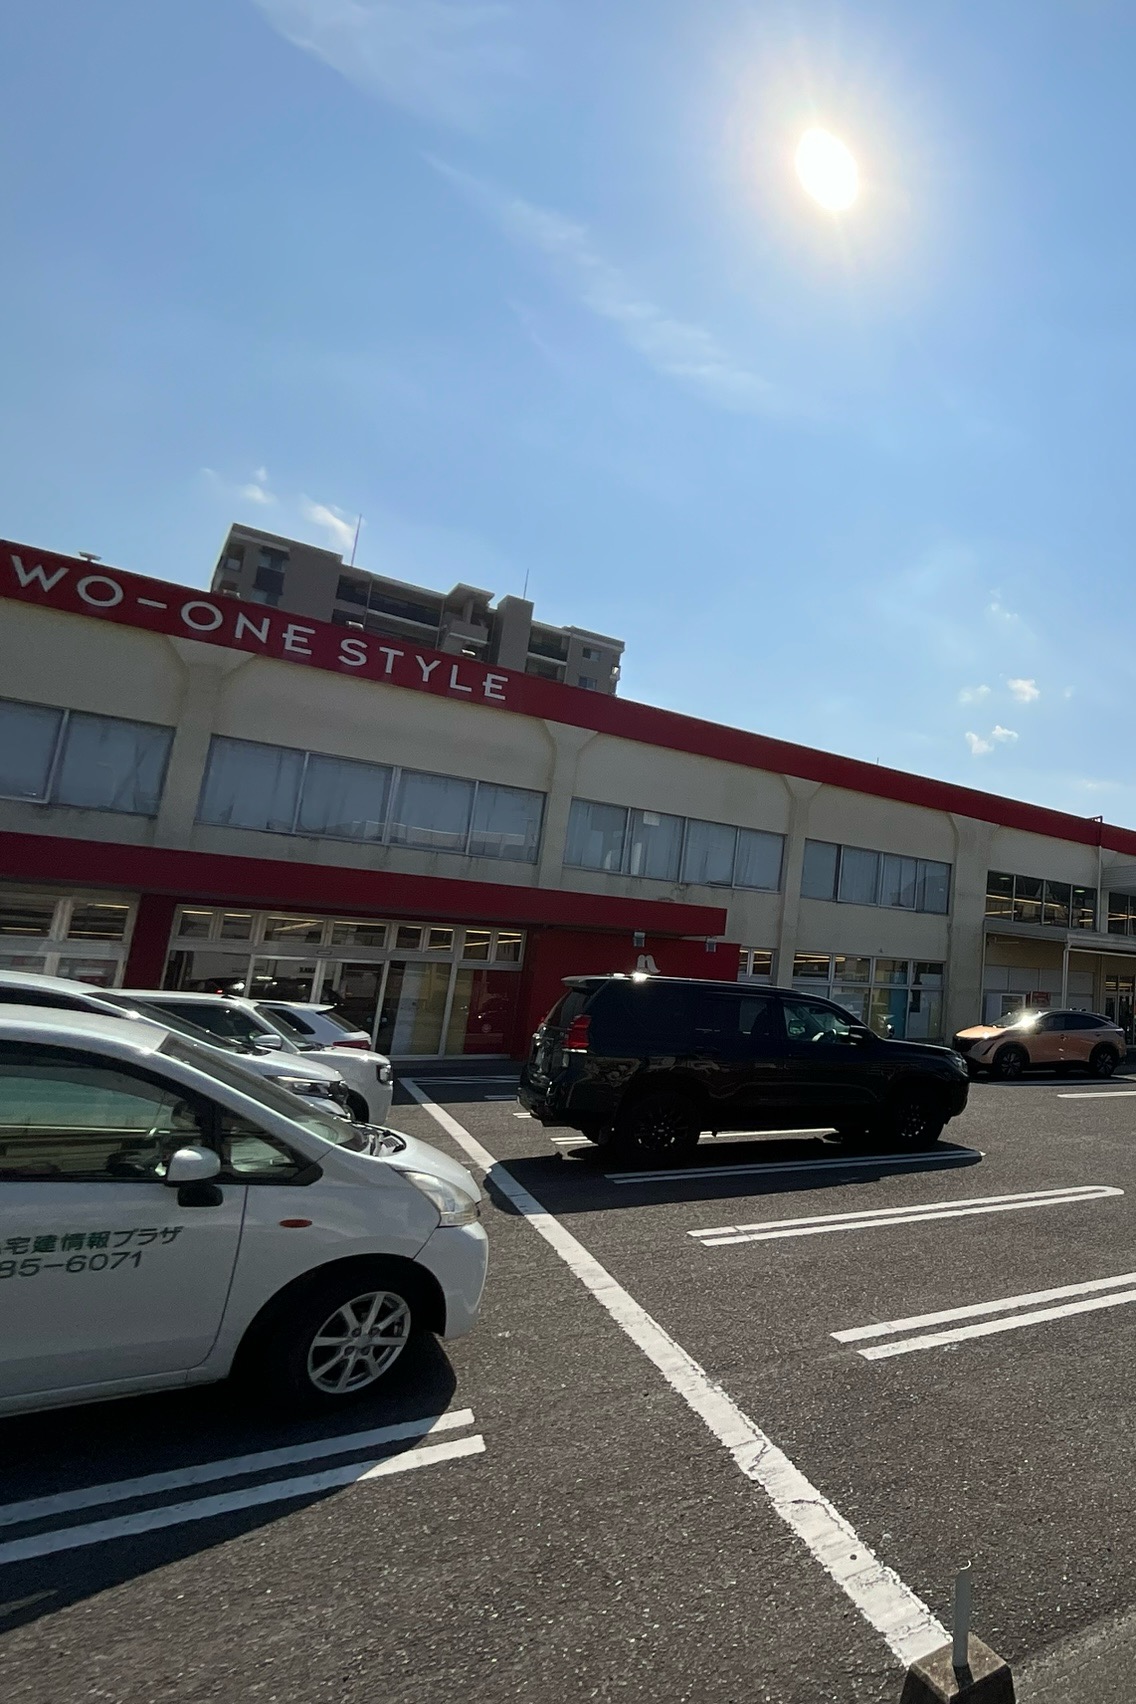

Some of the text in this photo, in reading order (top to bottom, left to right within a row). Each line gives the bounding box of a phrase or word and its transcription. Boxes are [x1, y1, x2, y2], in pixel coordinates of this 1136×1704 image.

[11, 555, 509, 700] WO-ONE STYLE
[0, 1226, 184, 1255] 宅建情報プラザ
